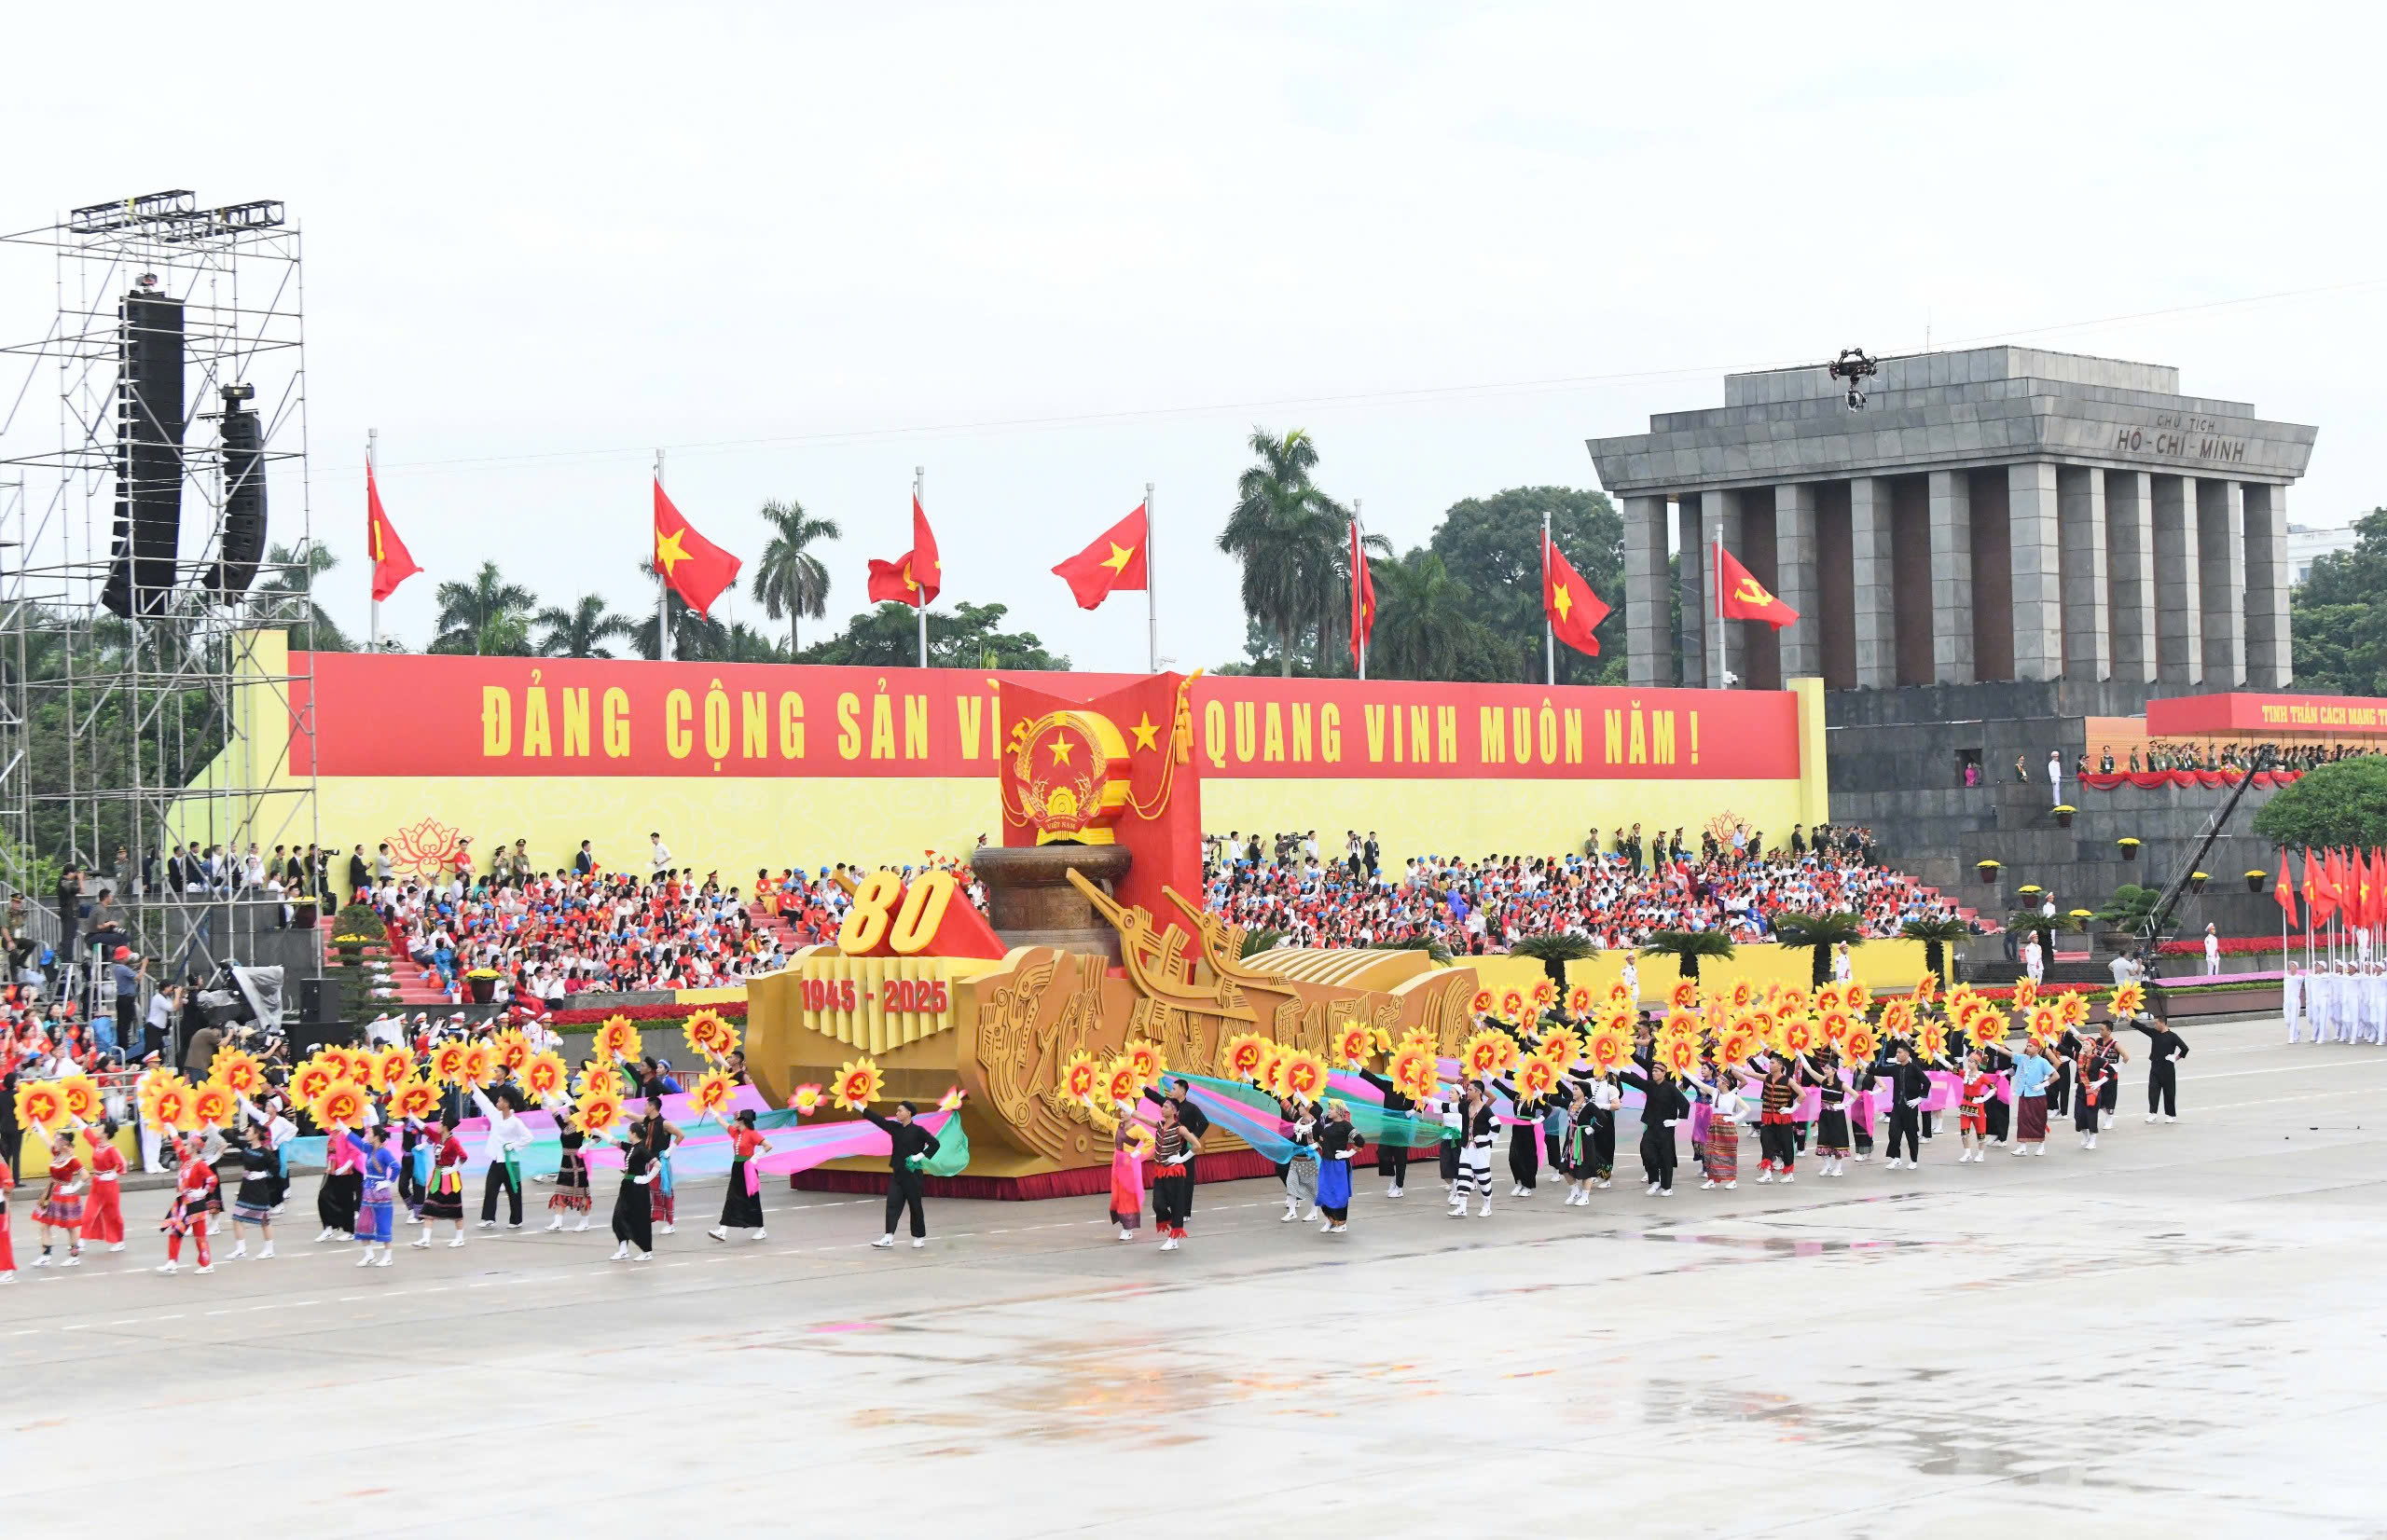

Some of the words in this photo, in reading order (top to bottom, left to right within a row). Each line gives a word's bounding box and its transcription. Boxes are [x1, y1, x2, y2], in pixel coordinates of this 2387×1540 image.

[481, 668, 630, 759] ĐẢNG
[665, 678, 805, 772] CỘNG
[836, 677, 929, 760] SẢN
[957, 695, 1000, 760] VI
[1205, 699, 1341, 769] QUANG
[1364, 704, 1457, 763] VINH
[1480, 696, 1583, 764] MUÔN
[1604, 699, 1676, 764] NĂM
[2261, 705, 2289, 723] TINH
[2320, 704, 2347, 725] CÁCH
[2348, 708, 2377, 729] MẠNG
[836, 870, 956, 955] 80
[799, 980, 857, 1013] 1945
[883, 980, 947, 1013] 2025
